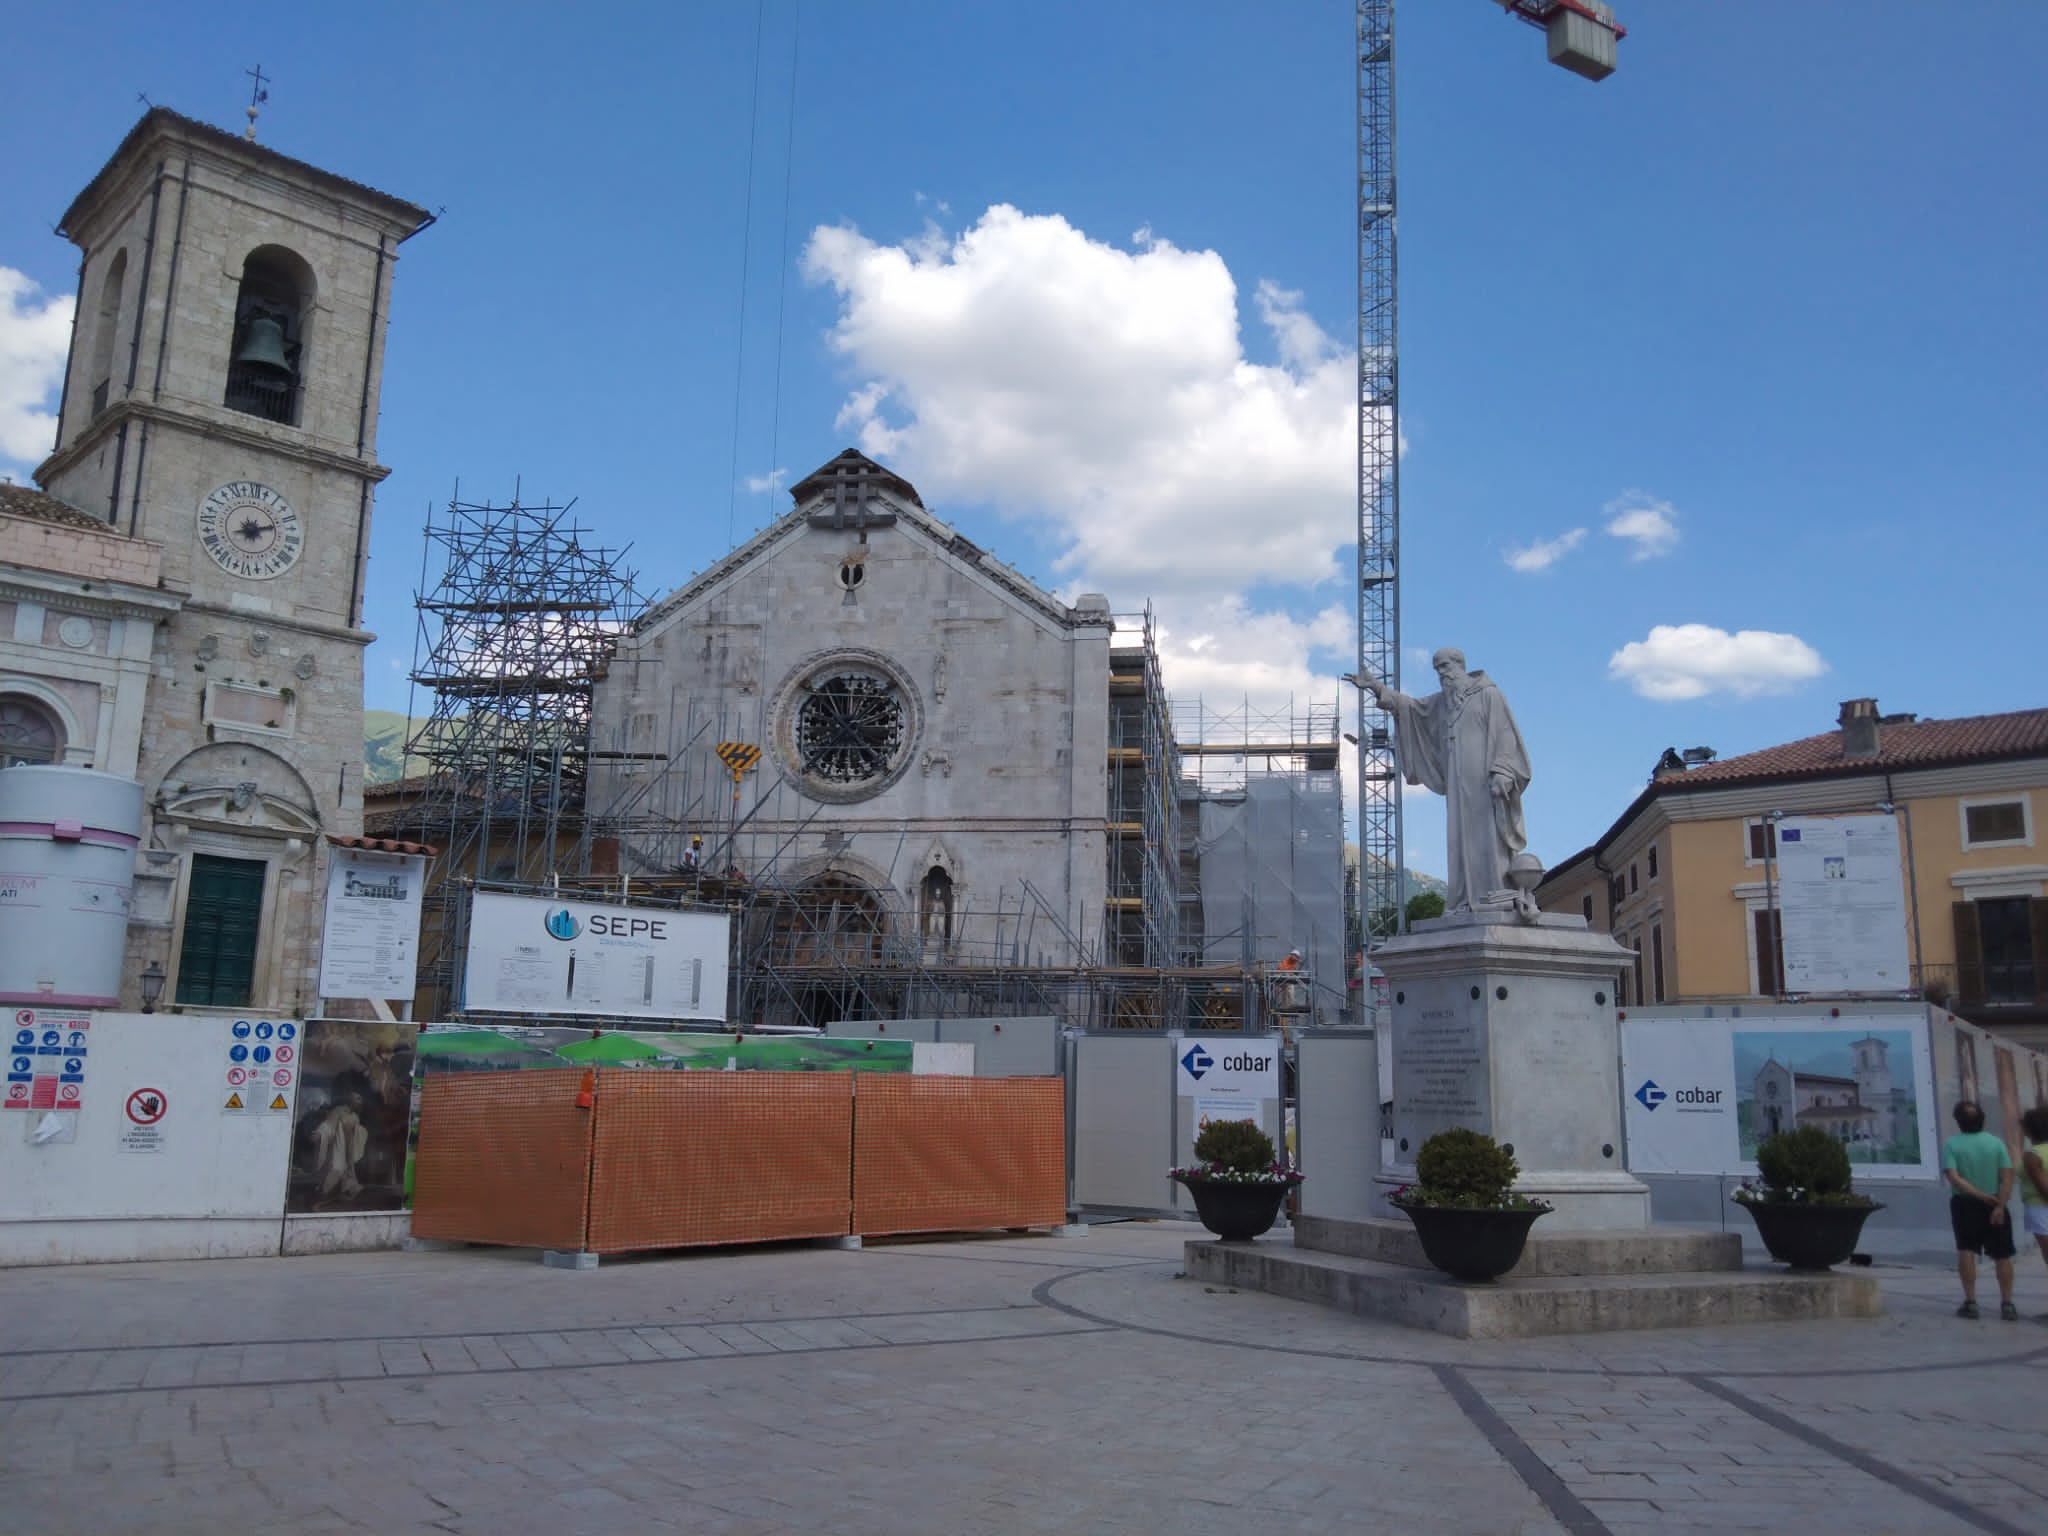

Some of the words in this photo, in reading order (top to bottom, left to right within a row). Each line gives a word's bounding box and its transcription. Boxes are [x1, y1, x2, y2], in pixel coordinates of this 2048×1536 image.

[589, 915, 668, 940] SEPE
[1223, 1051, 1272, 1072] cobar
[1676, 1086, 1722, 1103] cobar
